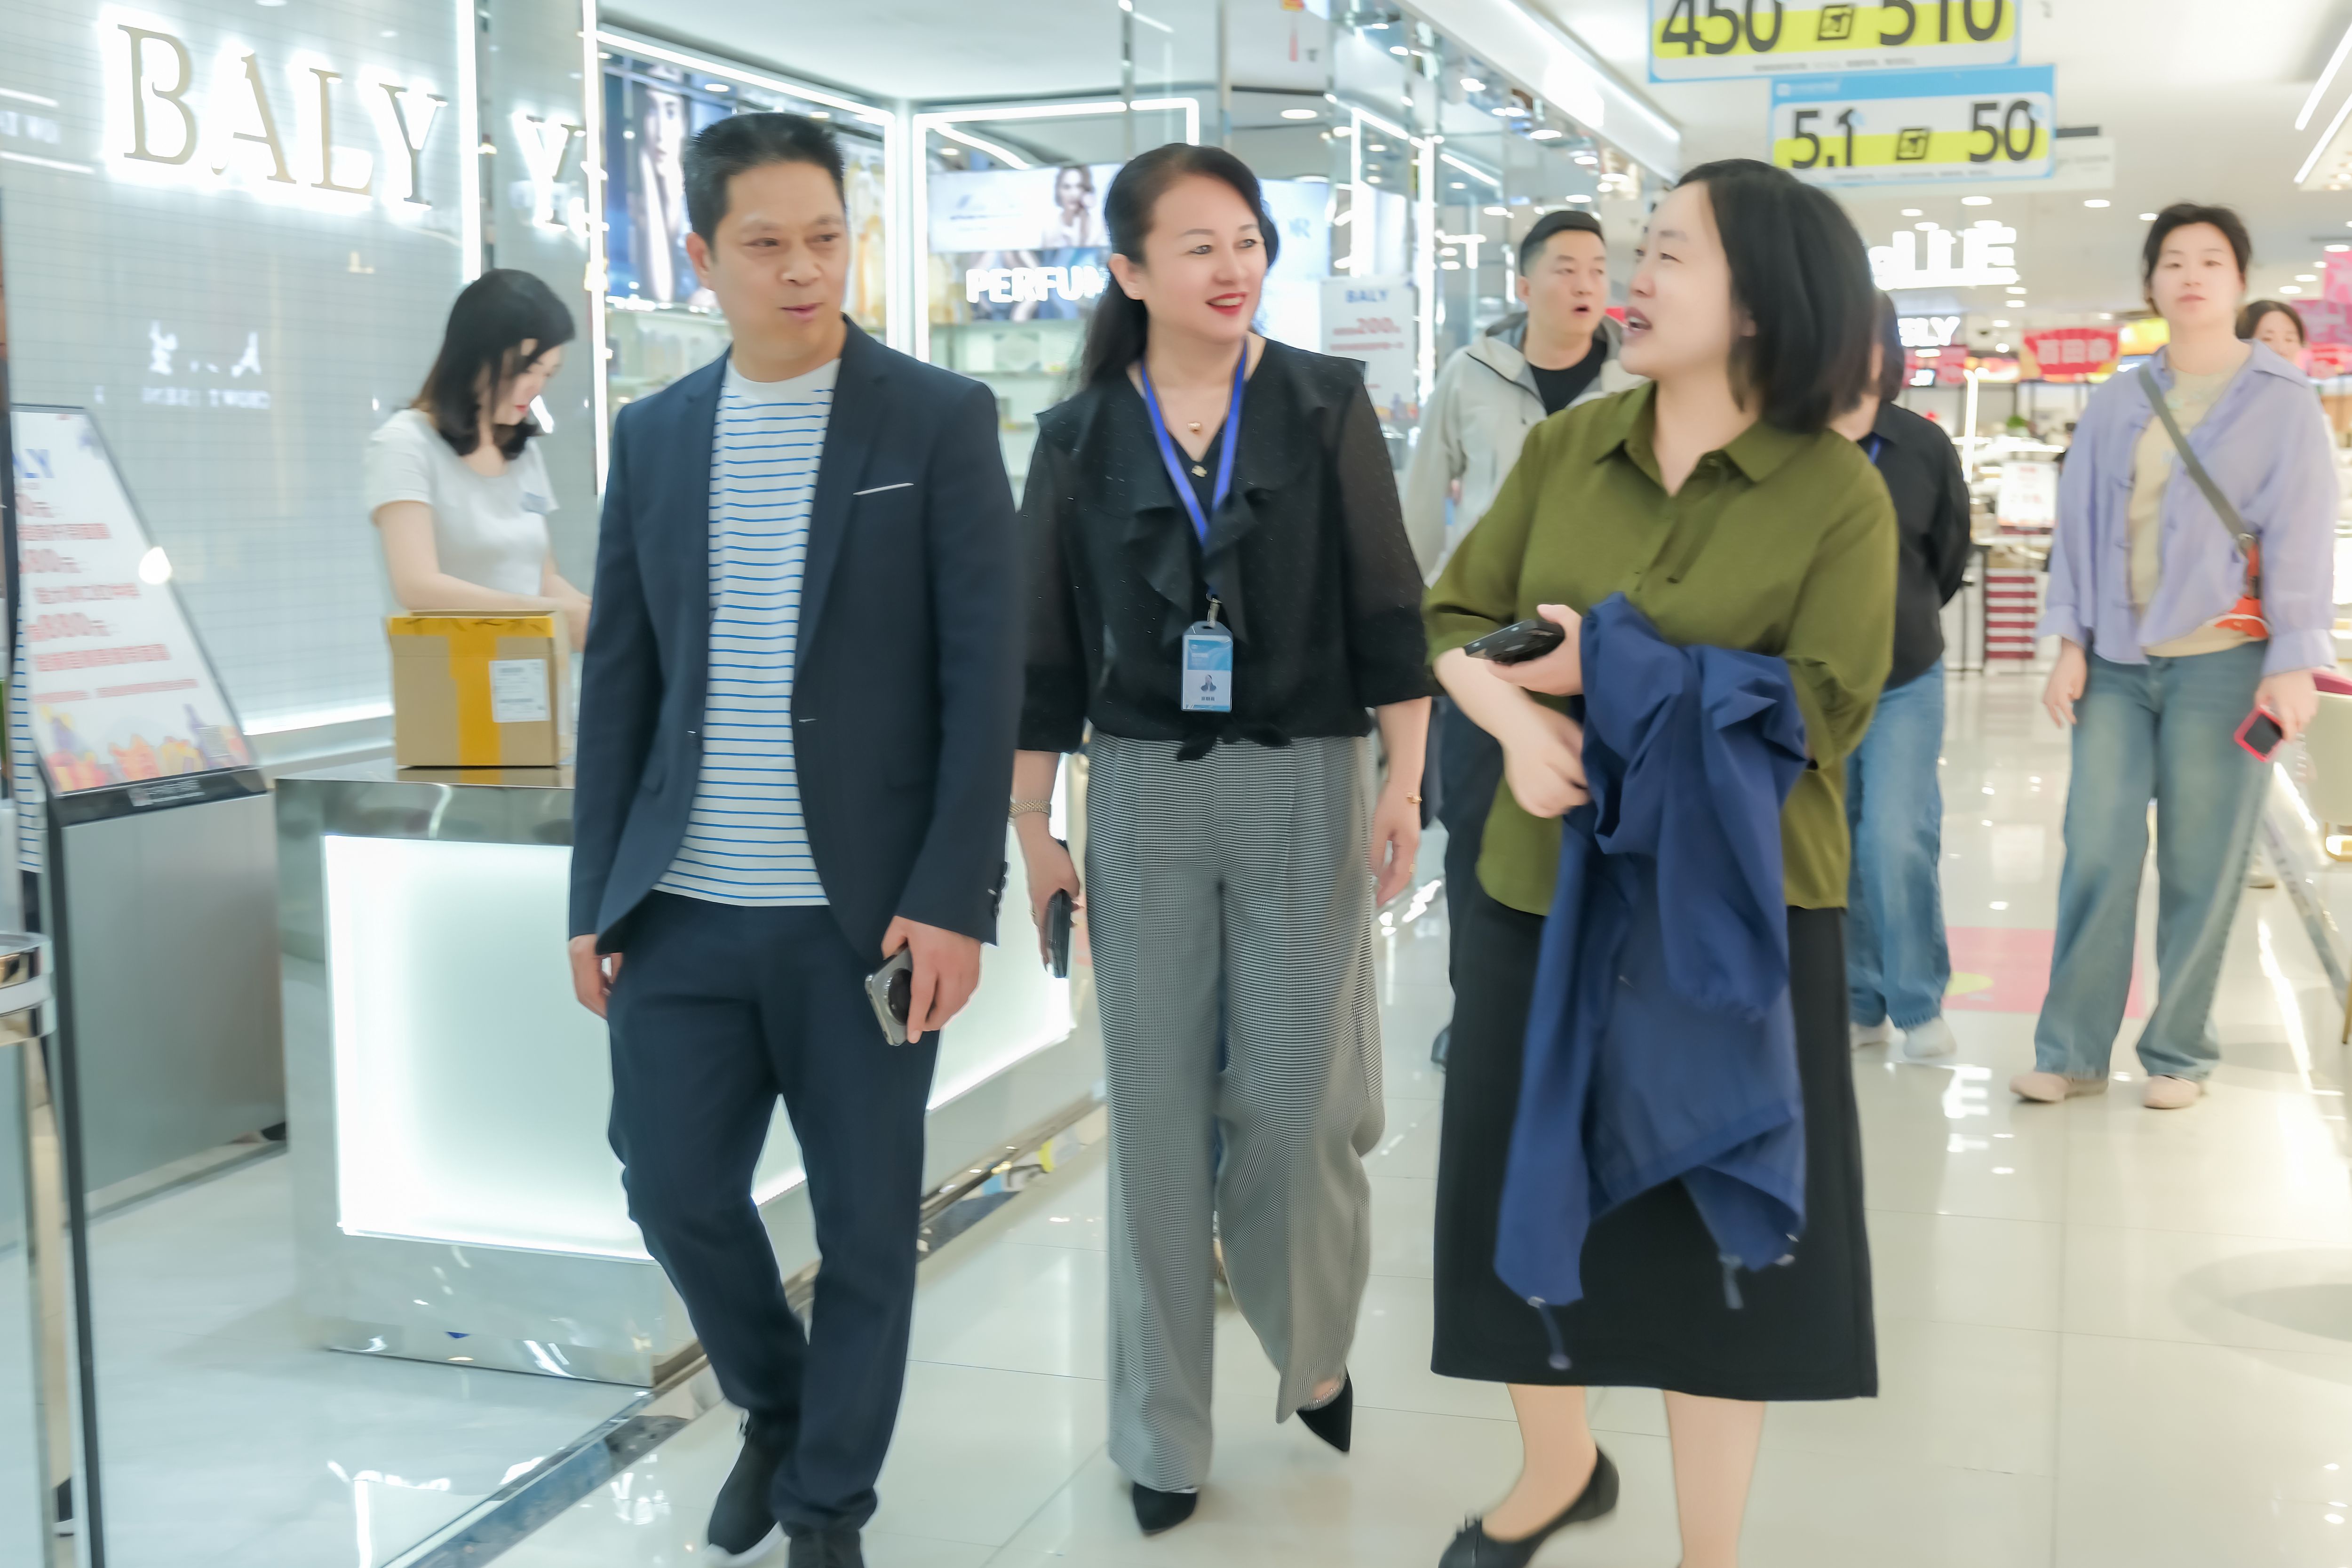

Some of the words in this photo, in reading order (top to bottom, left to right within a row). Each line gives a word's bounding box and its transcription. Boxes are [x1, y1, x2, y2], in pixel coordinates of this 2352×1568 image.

[1662, 0, 1782, 55] 450
[117, 24, 448, 209] BALY
[1792, 108, 1853, 168] 5.1
[1970, 100, 2035, 162] 50
[1345, 288, 1389, 303] BALY
